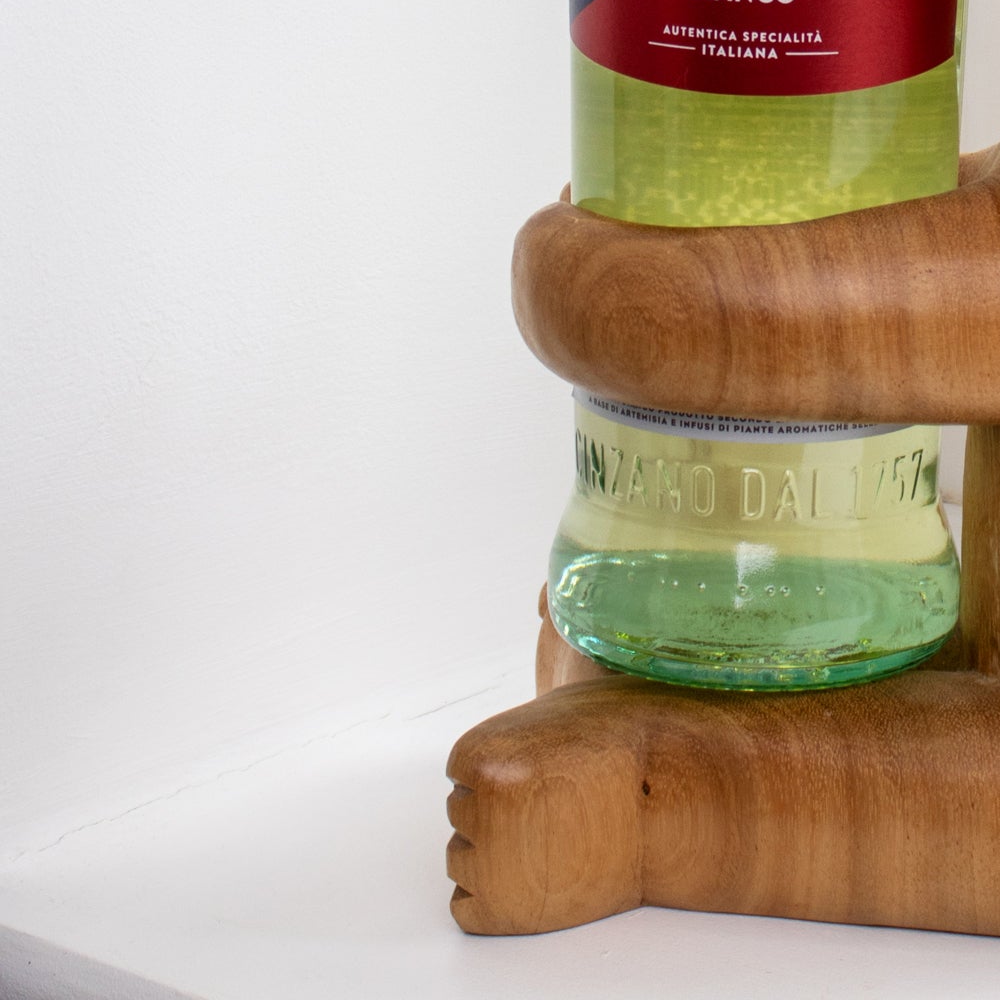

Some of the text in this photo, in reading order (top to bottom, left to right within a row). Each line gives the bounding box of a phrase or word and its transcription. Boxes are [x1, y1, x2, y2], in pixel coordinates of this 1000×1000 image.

[662, 24, 823, 43] AUTENTICA SPECIALITÀ
[701, 43, 779, 60] ITALIANA
[610, 404, 619, 414] DI
[620, 407, 667, 425] ARTEMISIA
[671, 418, 676, 427] E
[679, 419, 715, 431] INFUSI
[718, 422, 729, 432] DI
[733, 424, 774, 434] PIANTE
[777, 423, 849, 434] AROMATICHE
[575, 427, 716, 518] CINZANO
[739, 466, 833, 521] DAL
